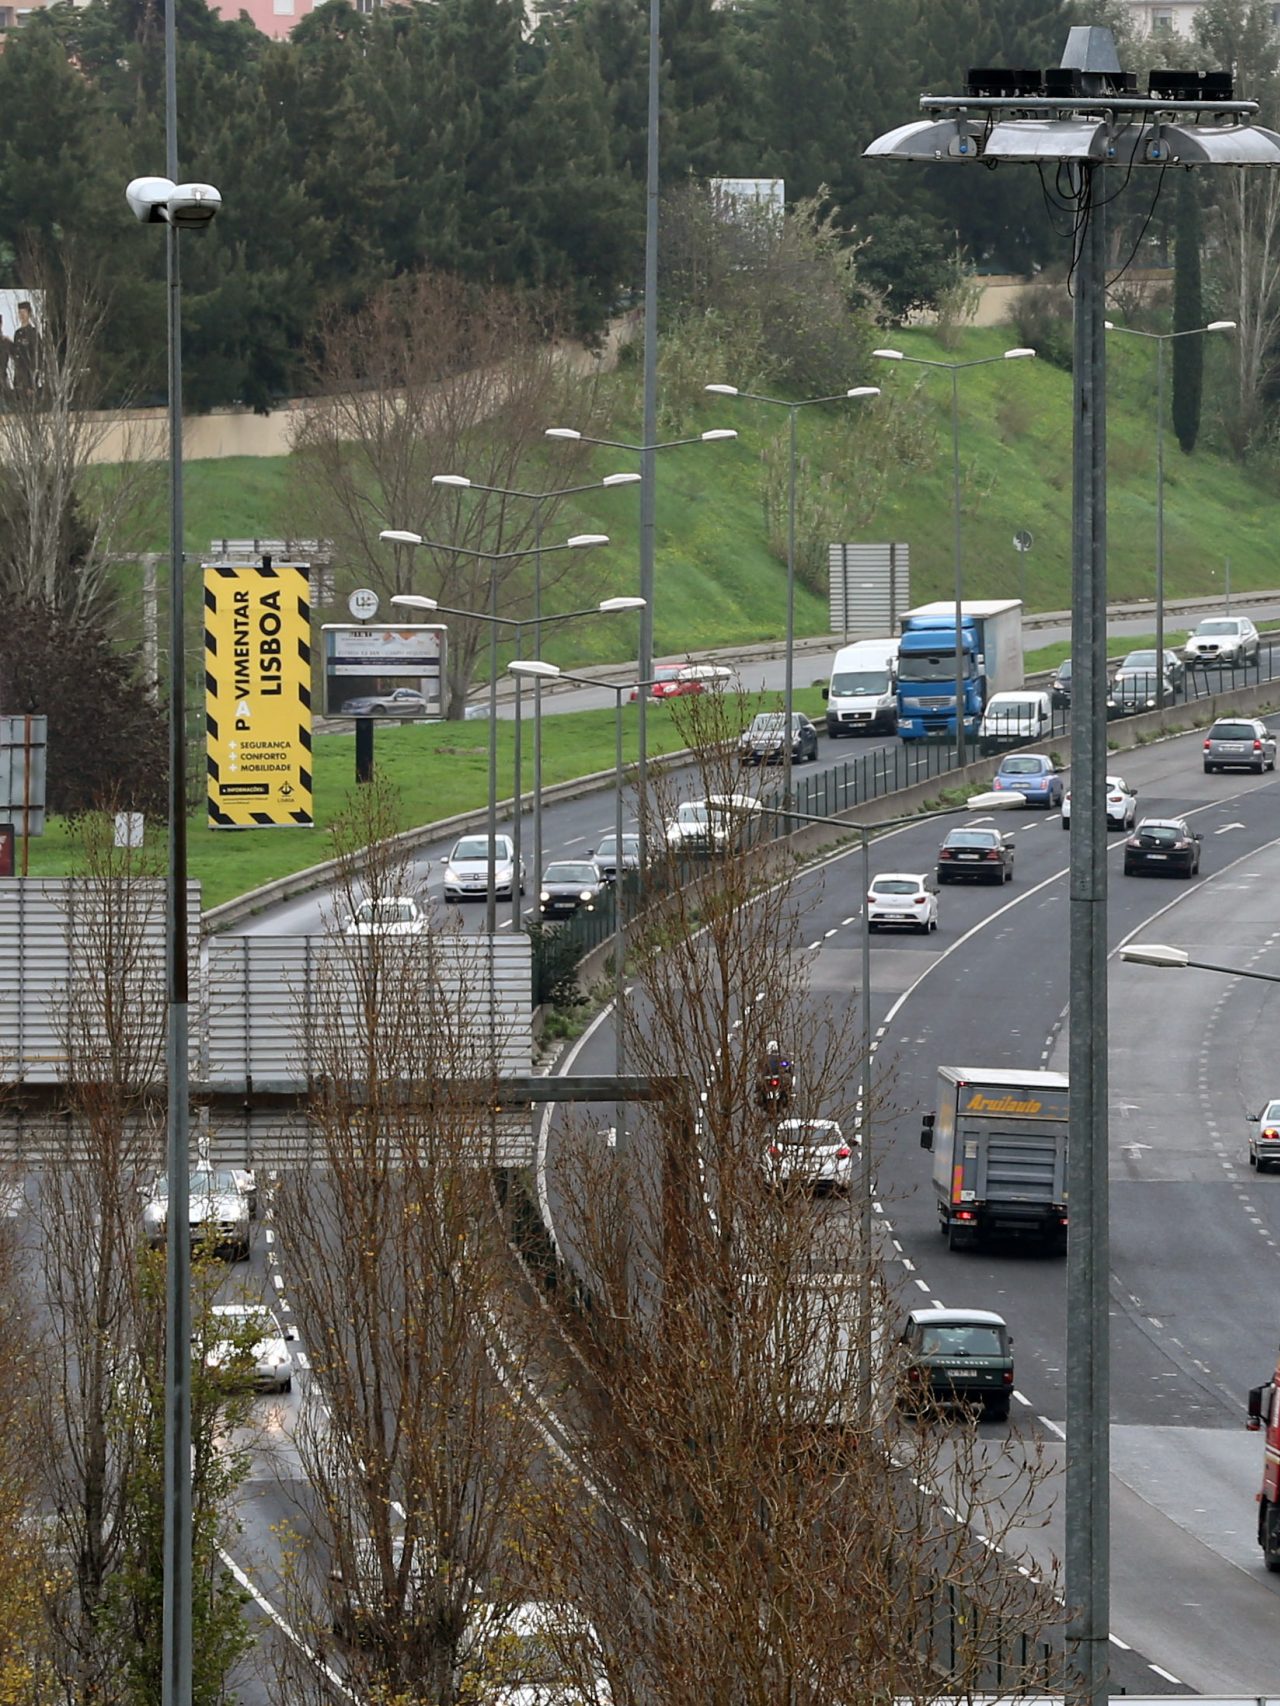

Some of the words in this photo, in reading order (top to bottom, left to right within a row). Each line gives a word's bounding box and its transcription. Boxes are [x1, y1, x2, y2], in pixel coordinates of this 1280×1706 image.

[234, 590, 251, 731] PAVIMENTAR
[259, 590, 282, 695] LISBOA
[240, 742, 291, 751] SEGURANÇA
[240, 764, 291, 772] MOBILIDADE
